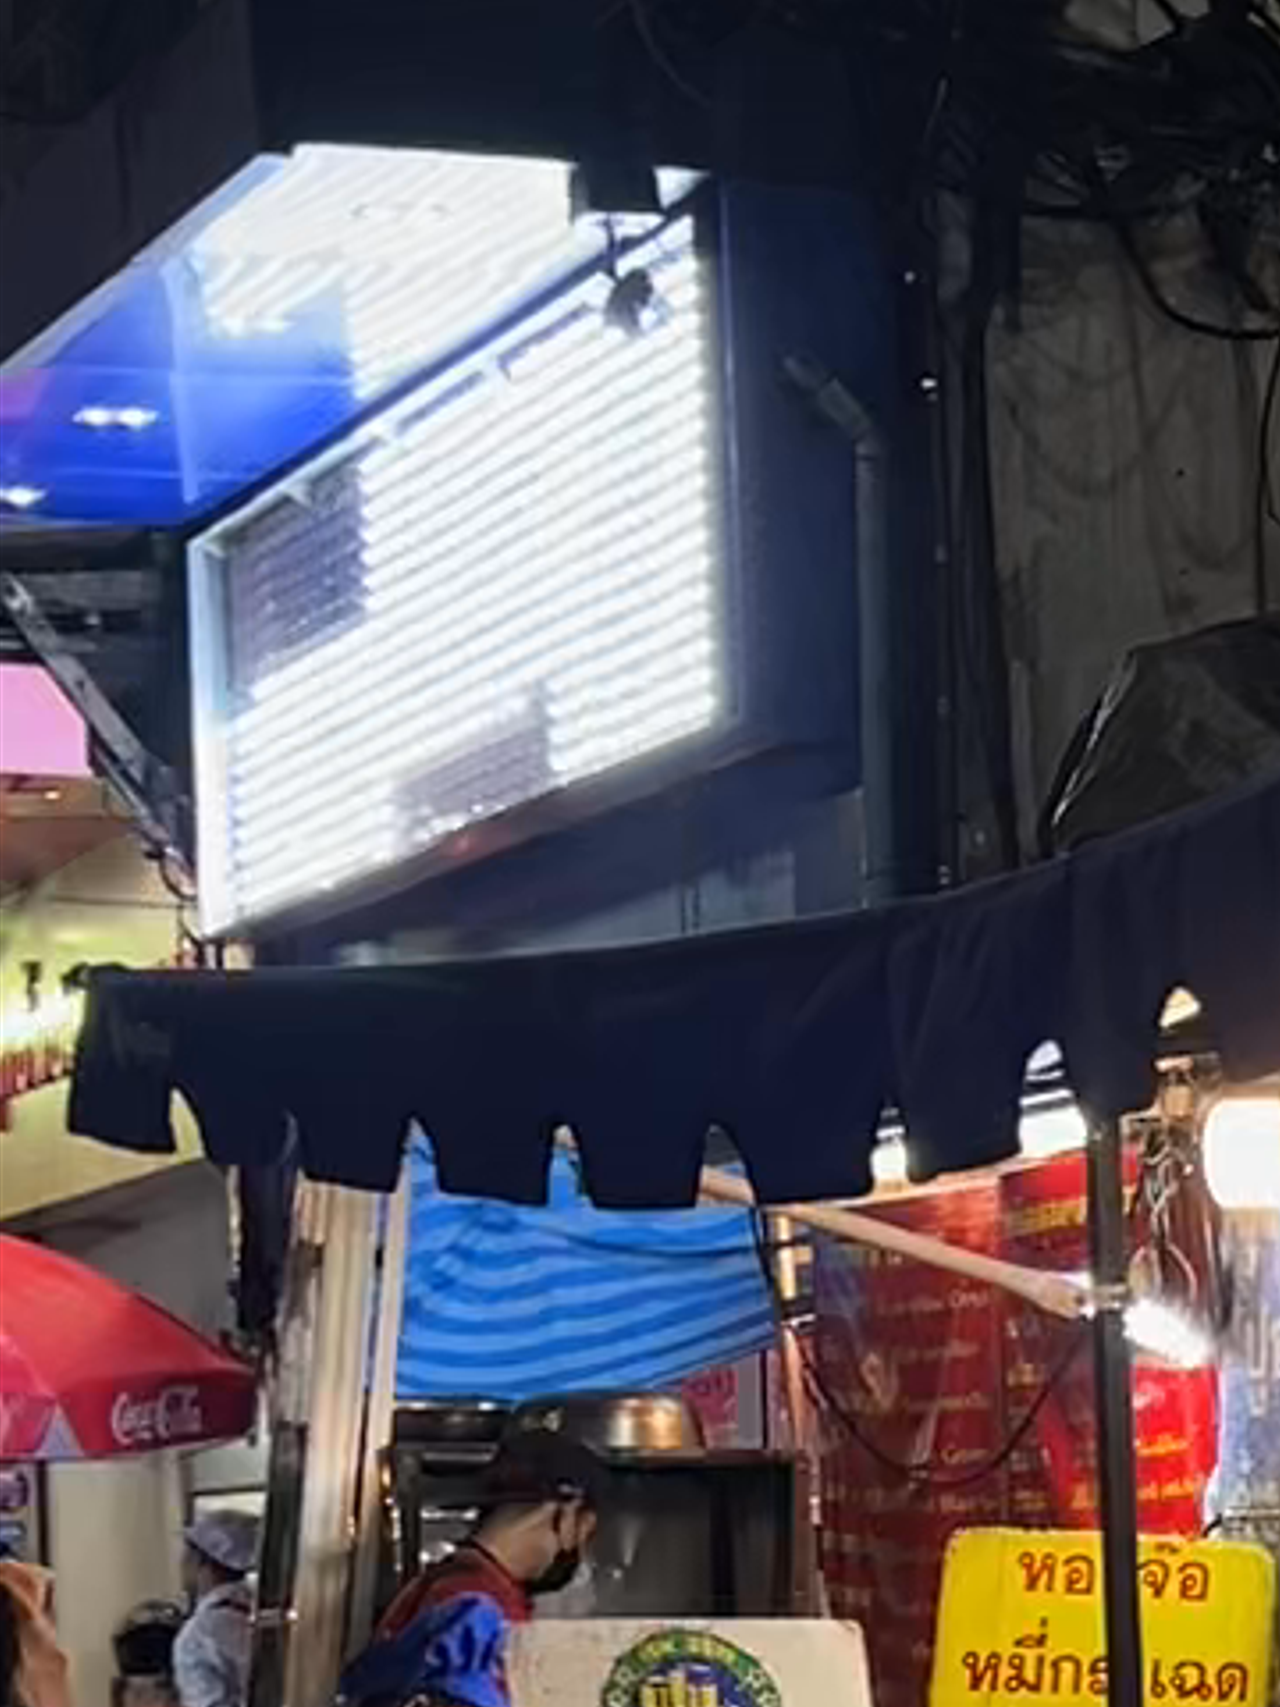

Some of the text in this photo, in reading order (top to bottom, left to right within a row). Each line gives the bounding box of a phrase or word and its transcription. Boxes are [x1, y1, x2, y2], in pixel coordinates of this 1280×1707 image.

[1018, 1541, 1211, 1601] หอจ๊อ
[961, 1618, 1249, 1702] หมี่กรเฉด
